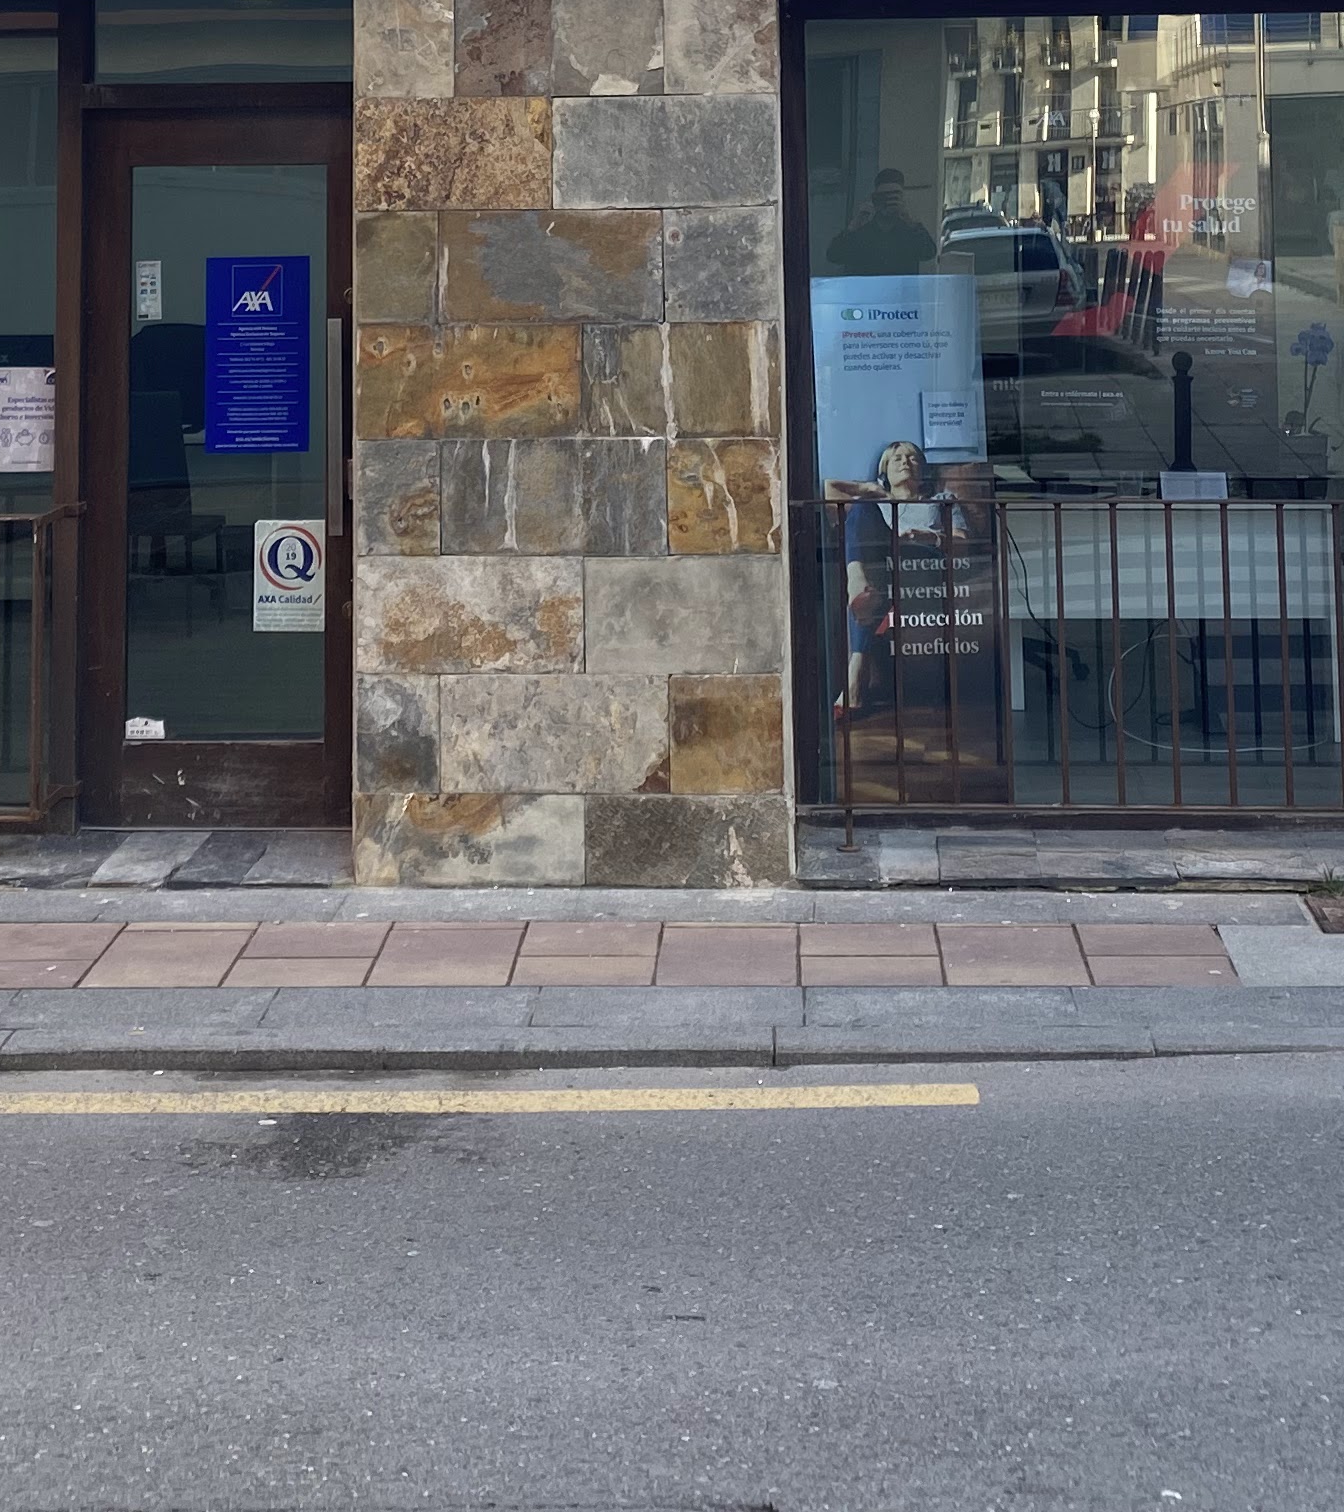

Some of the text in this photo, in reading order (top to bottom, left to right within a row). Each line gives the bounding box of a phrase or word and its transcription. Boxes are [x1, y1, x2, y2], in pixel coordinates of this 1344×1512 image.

[1179, 194, 1256, 214] Protege
[1162, 215, 1241, 233] tu salud
[232, 291, 274, 312] AXA
[867, 308, 919, 321] iProtect
[892, 330, 929, 338] cobertura
[843, 342, 860, 351] para
[860, 342, 899, 350] inversores
[933, 341, 949, 350] que
[843, 351, 942, 362] puedes activar y desactivar
[843, 363, 872, 371] cuando
[257, 595, 313, 604] AXA Calidad
